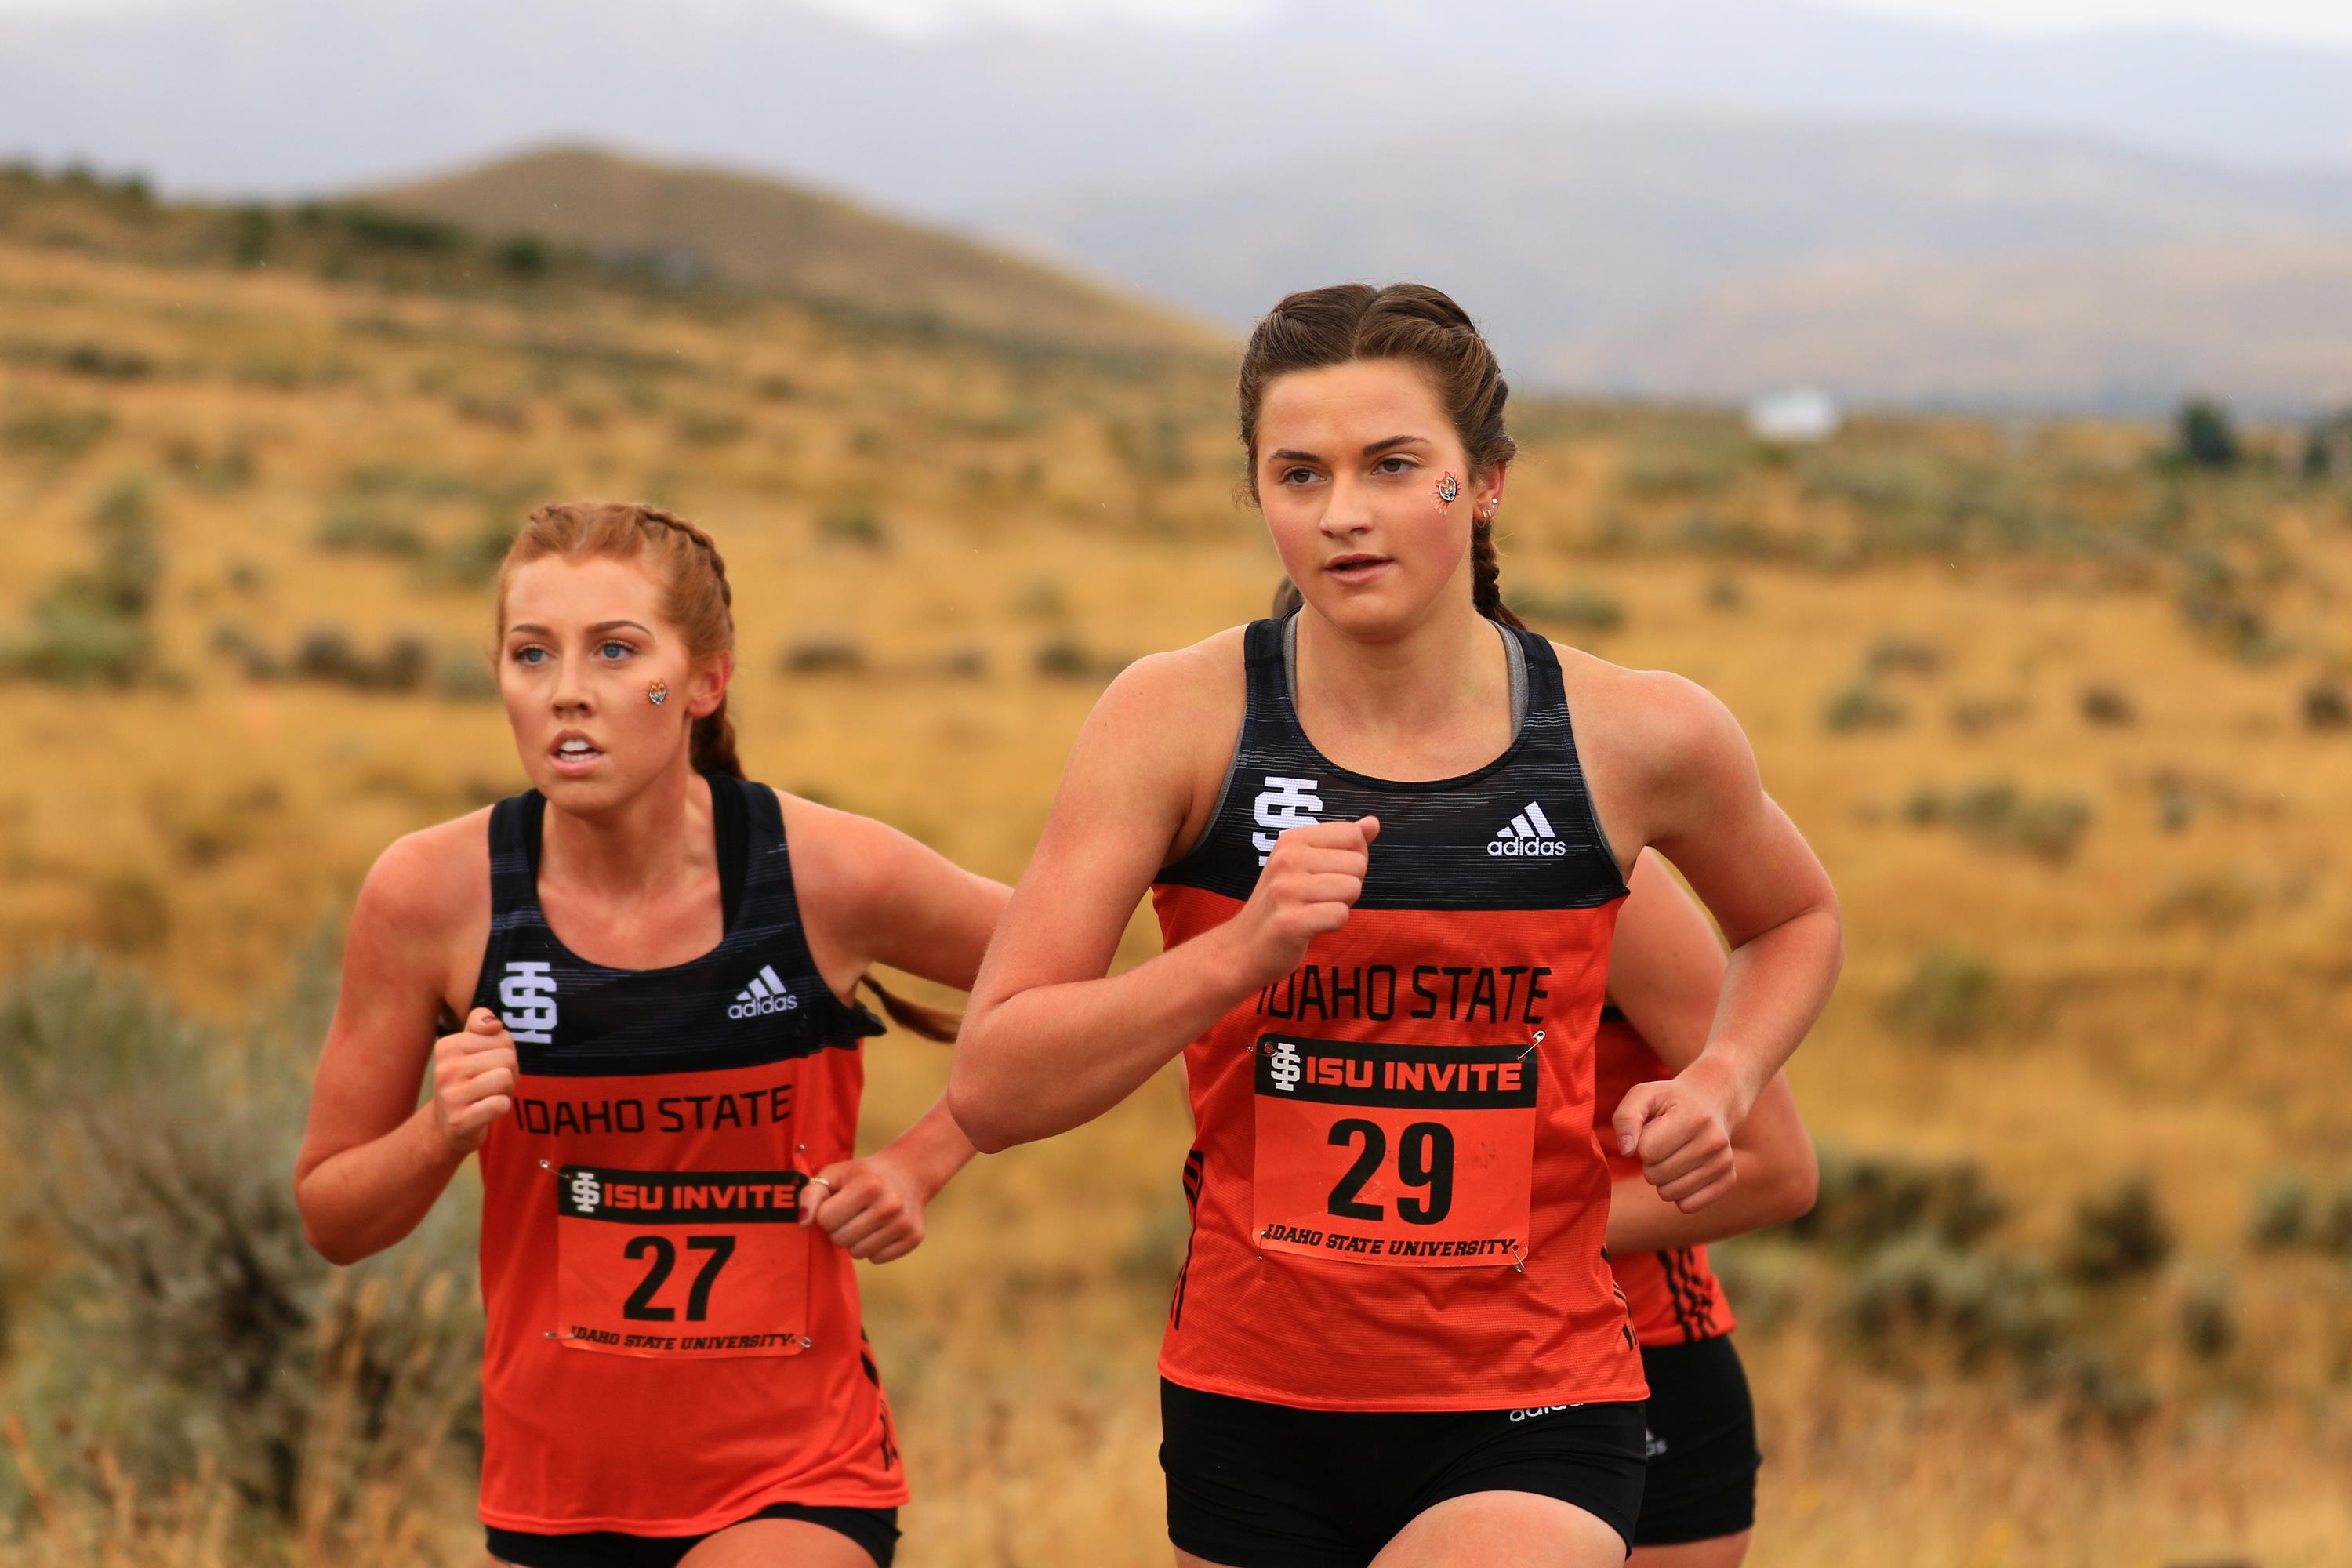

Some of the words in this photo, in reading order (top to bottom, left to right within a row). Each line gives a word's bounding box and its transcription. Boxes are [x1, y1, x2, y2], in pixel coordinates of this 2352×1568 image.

[1487, 837, 1566, 857] adidas
[728, 993, 797, 1019] adidas
[1410, 965, 1552, 1025] STATE
[1306, 1056, 1374, 1088] ISU
[1385, 1062, 1523, 1091] INVITE
[514, 1098, 644, 1136] IDAHO
[658, 1084, 792, 1133] STATE
[1327, 1118, 1454, 1225] 29
[604, 1183, 663, 1210] ISU
[673, 1185, 796, 1210] INVITE
[1265, 1224, 1323, 1246] IDAHO
[1326, 1233, 1385, 1254] STATE
[1388, 1239, 1516, 1257] UNIVERSITY
[622, 1235, 736, 1322] 27
[572, 1326, 620, 1345] IDAHO
[624, 1334, 677, 1350] STATE
[681, 1334, 794, 1350] UNIVERSITY
